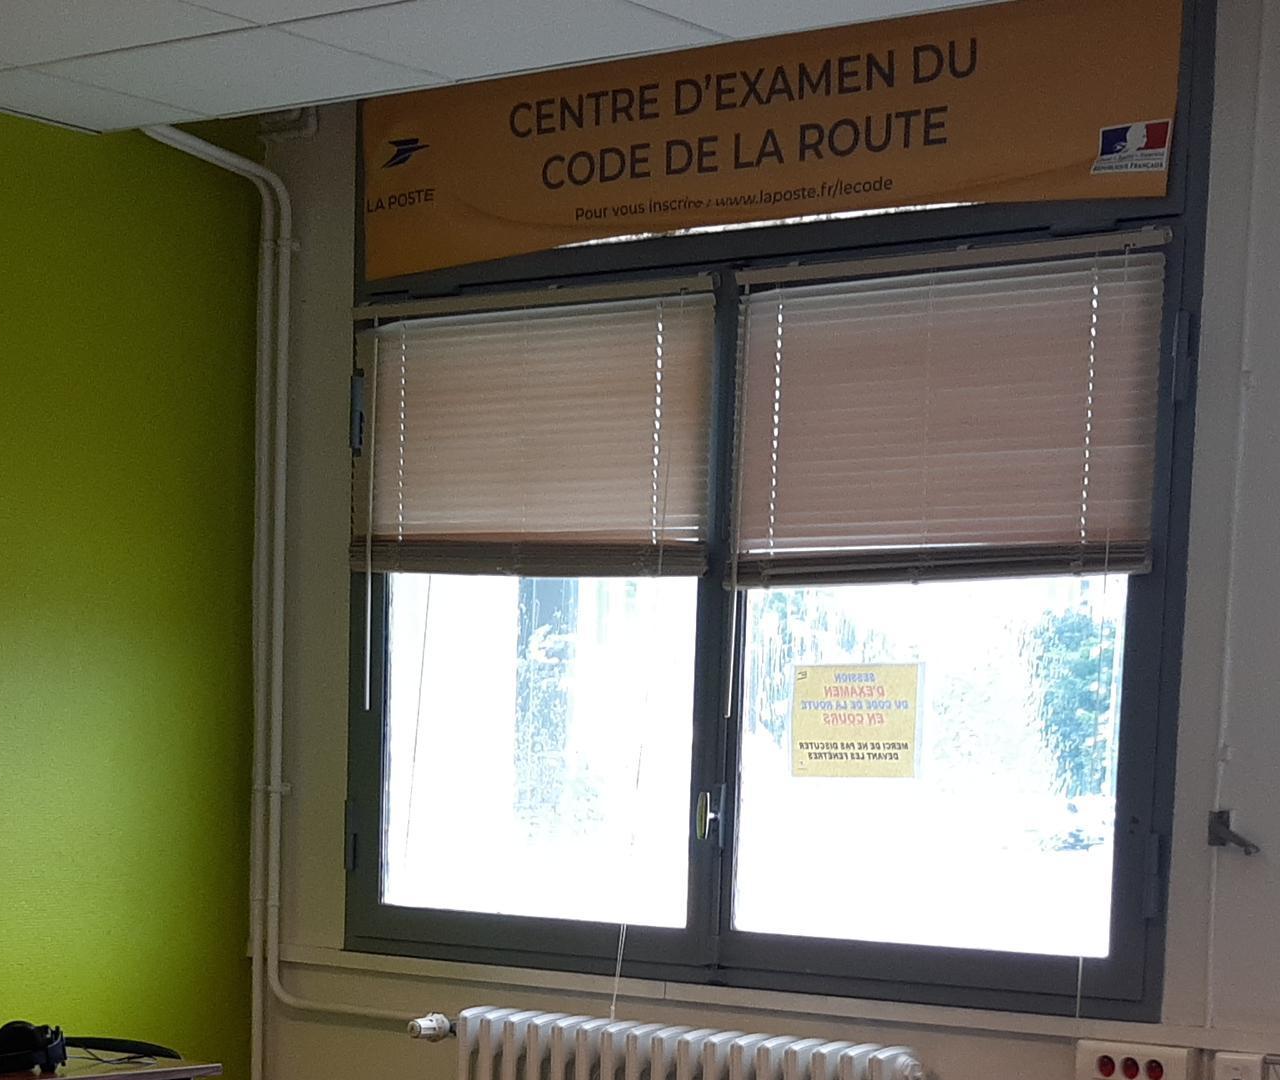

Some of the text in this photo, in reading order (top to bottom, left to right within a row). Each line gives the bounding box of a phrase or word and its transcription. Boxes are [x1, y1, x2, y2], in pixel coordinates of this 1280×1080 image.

[510, 37, 977, 138] CENTRE D'EXAMEN DU
[542, 105, 948, 190] CODE DE LA ROUTE
[367, 188, 435, 213] LA POSTE
[575, 207, 608, 221] Pour
[612, 204, 645, 217] vous
[715, 176, 893, 209] www.laposte.fr/lecode
